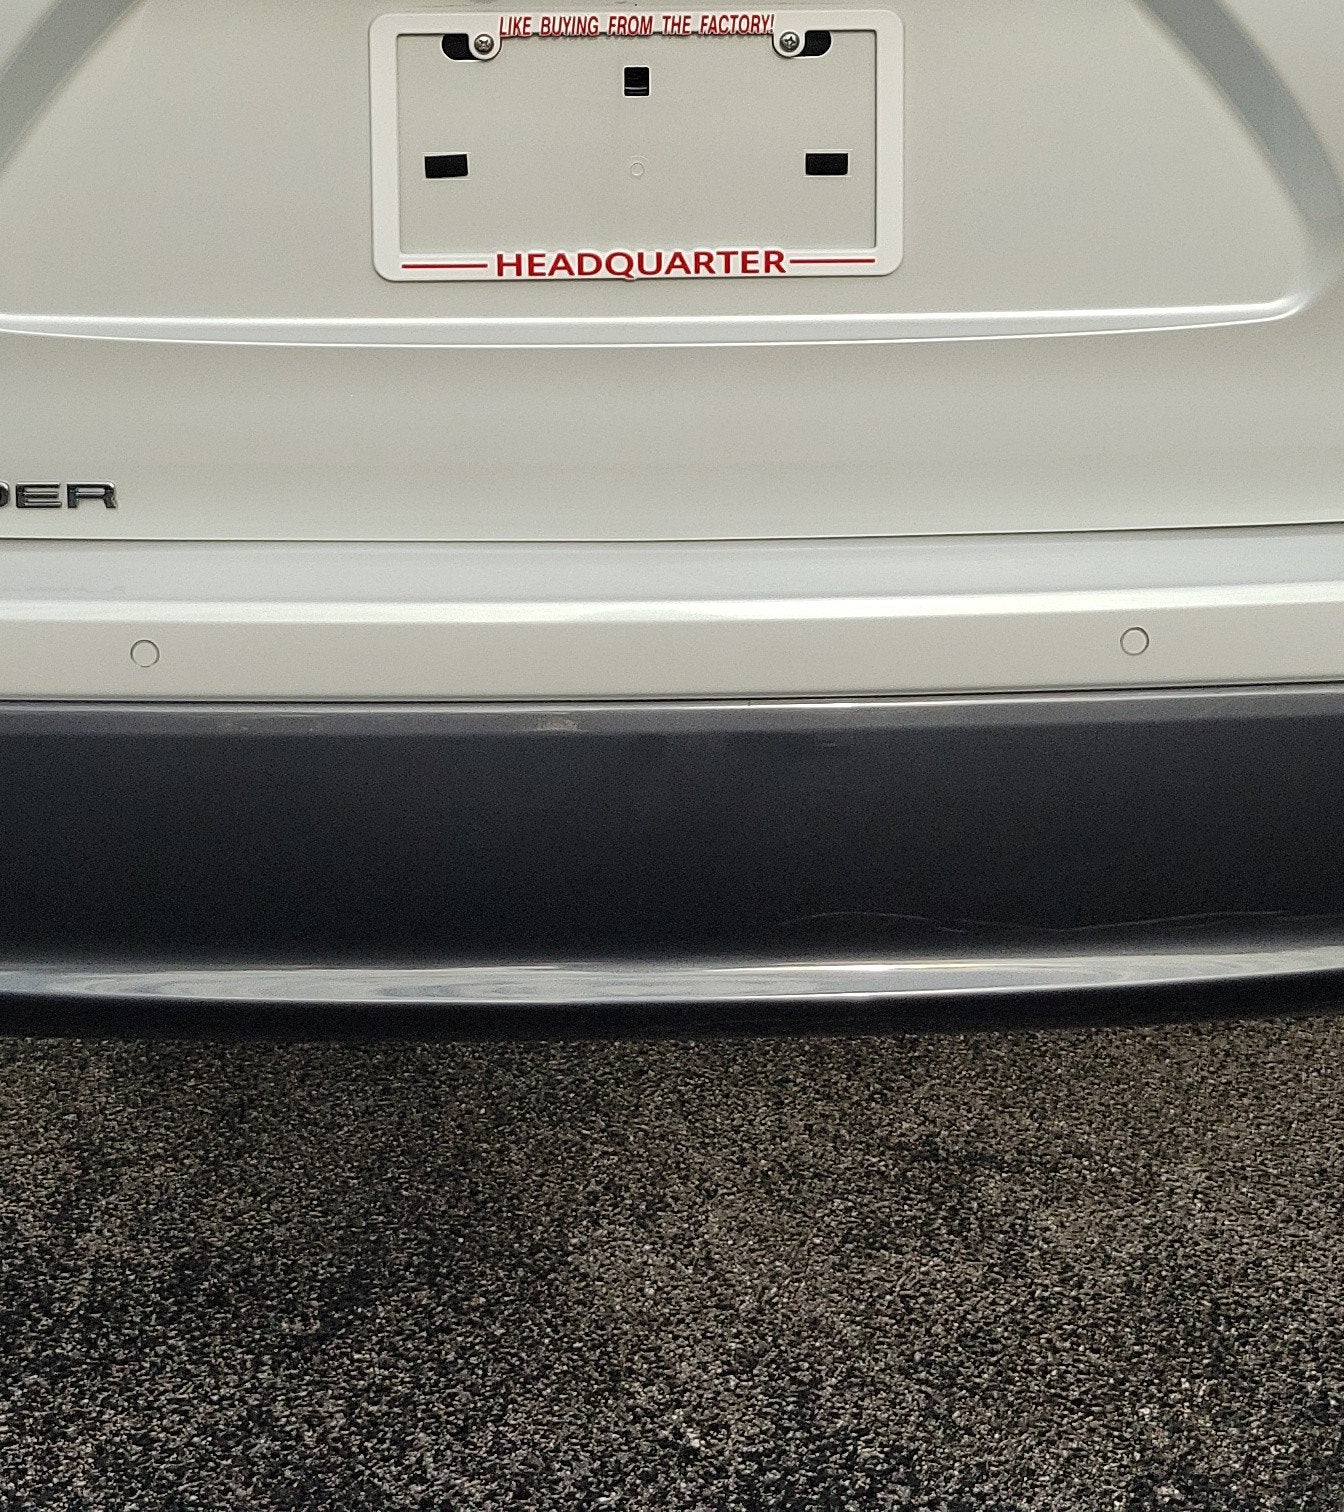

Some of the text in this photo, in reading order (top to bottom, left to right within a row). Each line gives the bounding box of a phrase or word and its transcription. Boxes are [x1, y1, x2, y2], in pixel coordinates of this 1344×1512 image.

[498, 13, 775, 37] LIKE BUYING FROM THE FACTORY!
[495, 249, 787, 279] HEADQUARTER
